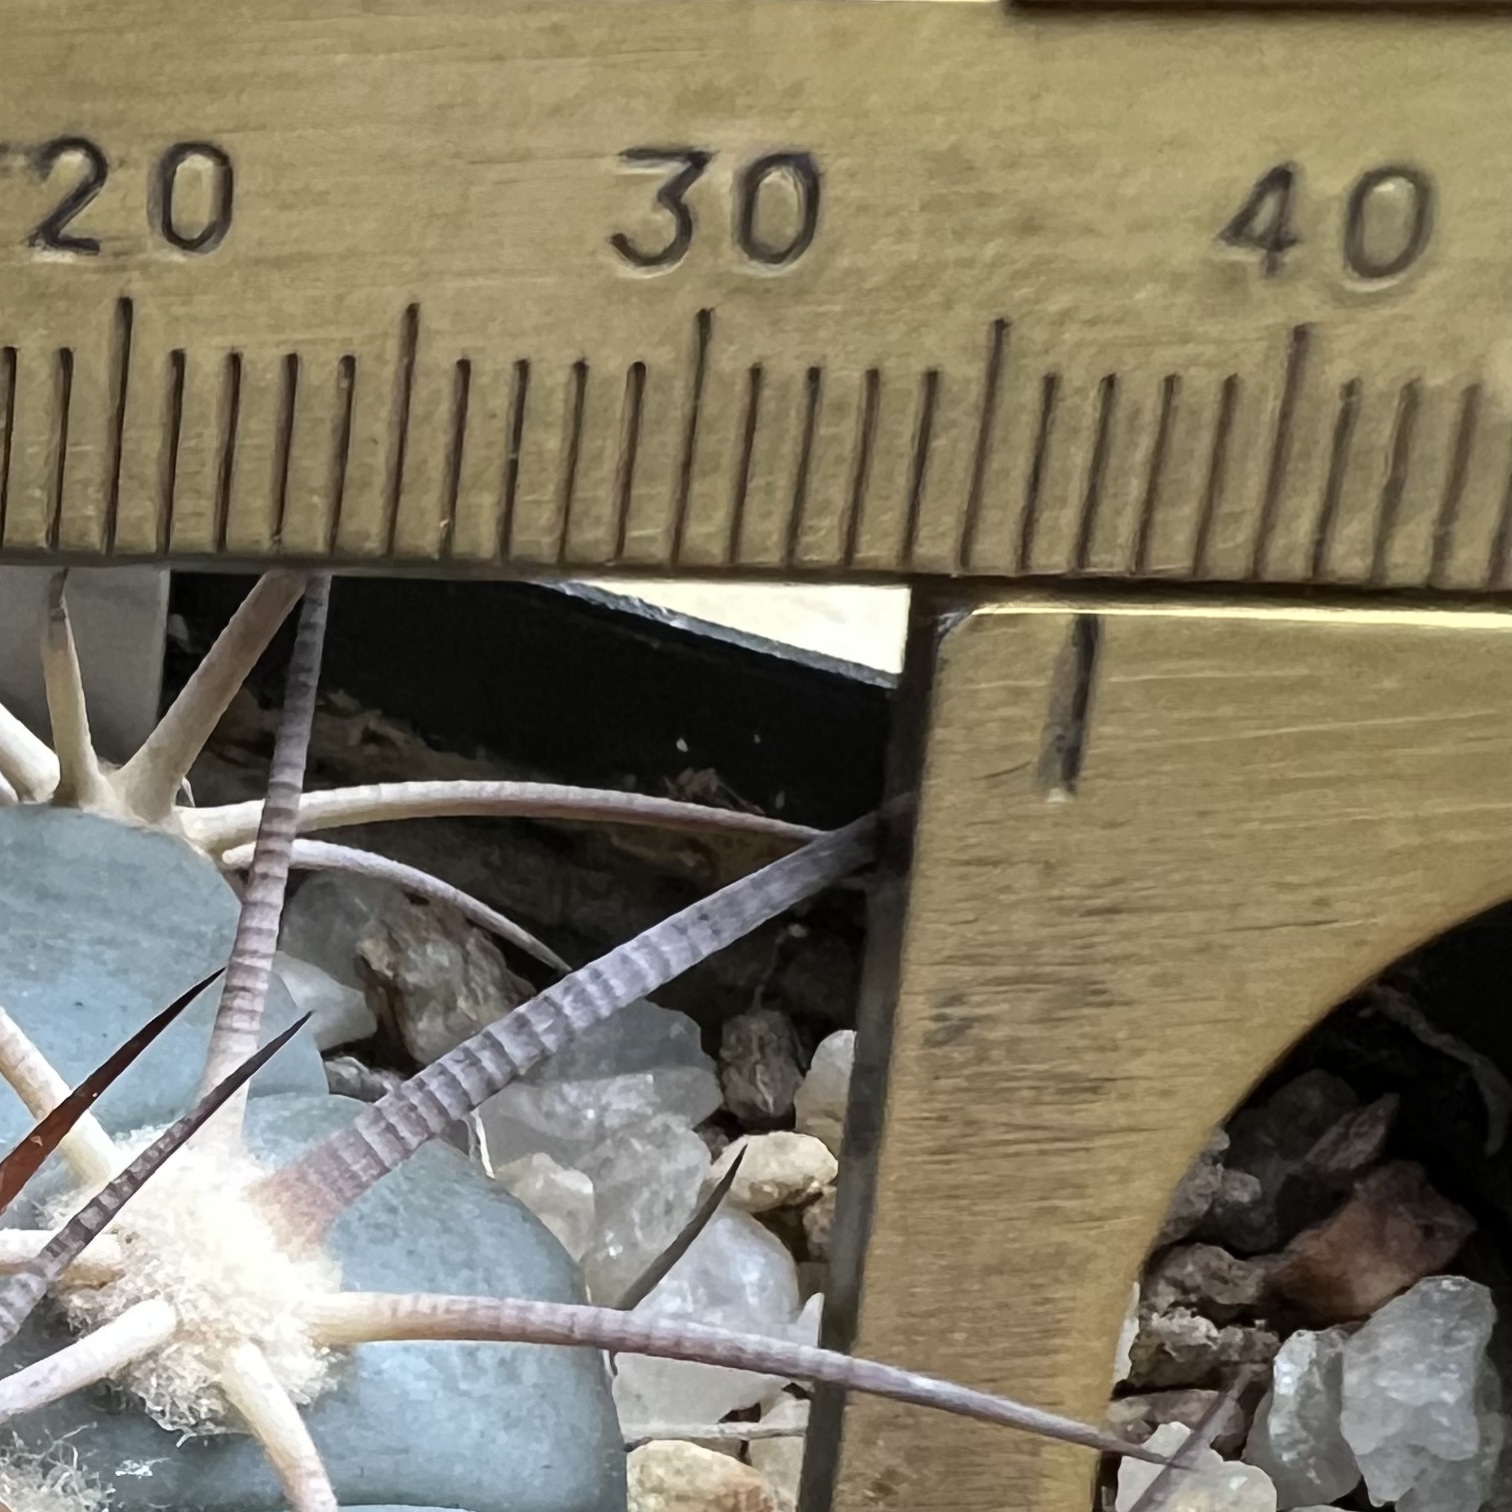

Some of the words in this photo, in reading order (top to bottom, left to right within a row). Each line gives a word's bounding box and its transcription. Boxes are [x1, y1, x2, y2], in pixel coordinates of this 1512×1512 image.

[27, 135, 234, 254] 20
[610, 146, 823, 268] 30
[1212, 160, 1434, 280] 40
